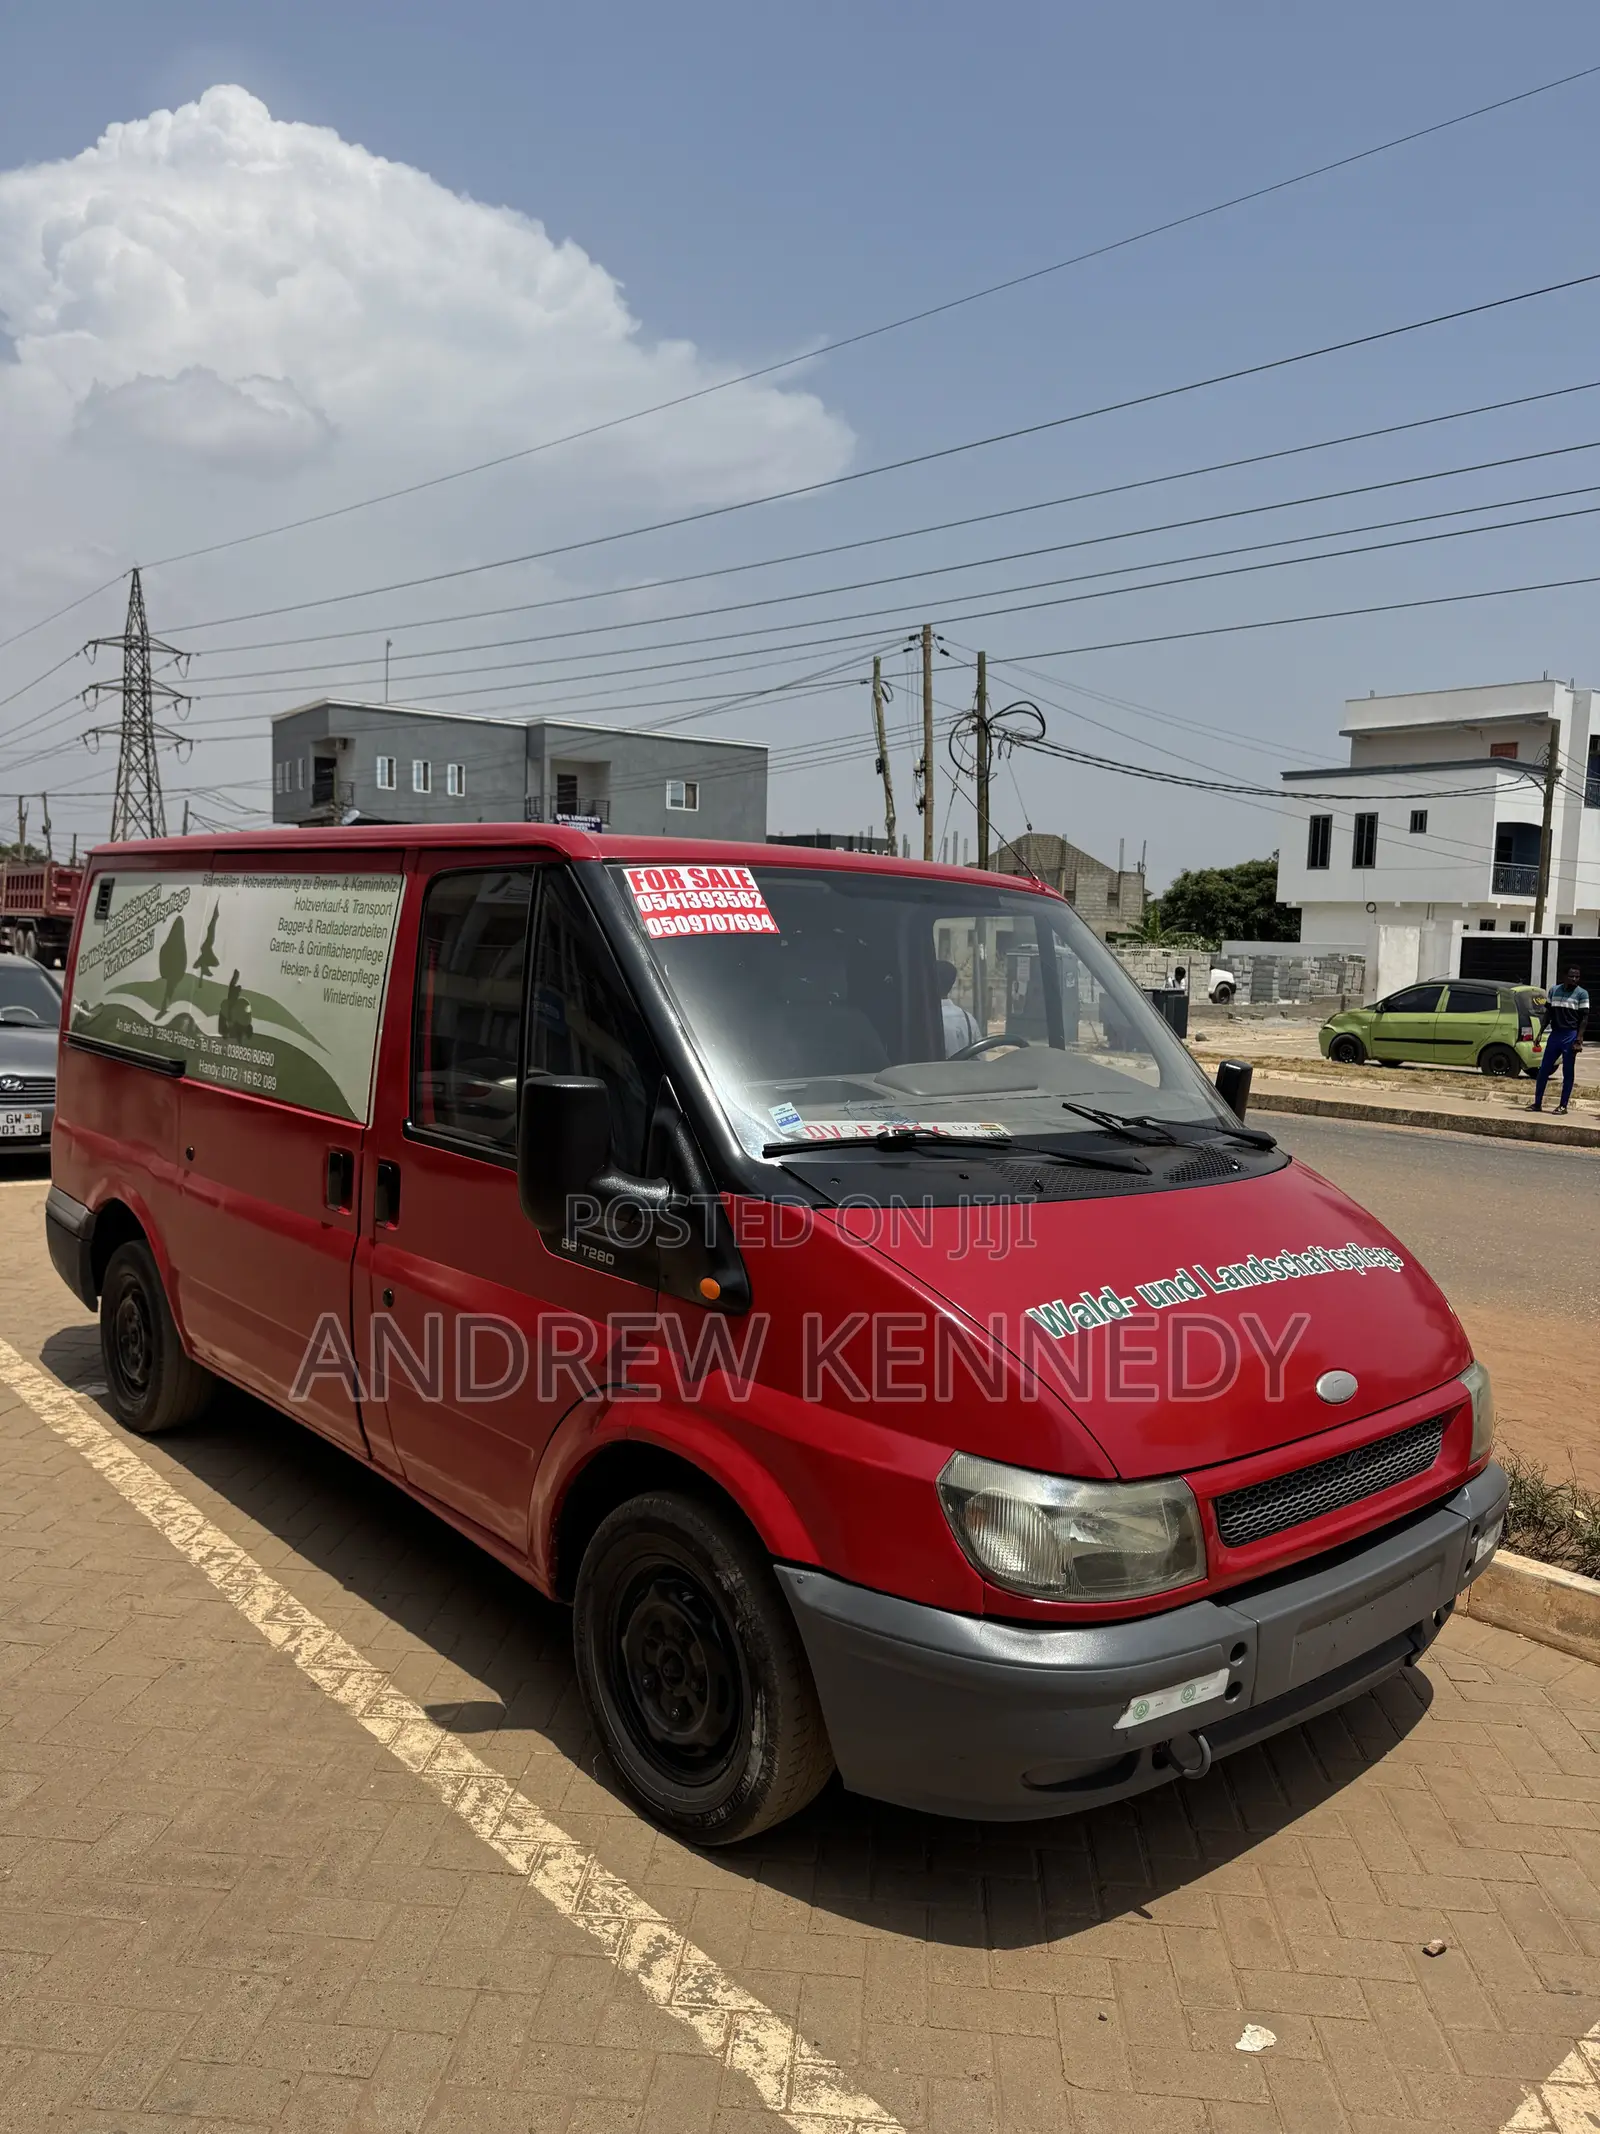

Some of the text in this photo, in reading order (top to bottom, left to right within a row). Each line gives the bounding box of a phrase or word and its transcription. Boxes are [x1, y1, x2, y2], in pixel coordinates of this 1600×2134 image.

[342, 876, 349, 892] &
[628, 867, 755, 892] FOR SALE
[353, 899, 393, 919] Transport
[636, 891, 767, 913] 0541393582
[315, 919, 388, 939] Radladerarbeiten
[645, 914, 775, 936] 0509707694
[269, 937, 384, 966] Garten- & Grünflächenpflege
[280, 960, 380, 988] Hecken- & Grabenpflege
[323, 988, 376, 1009] Winterdienst
[221, 1065, 238, 1081] 0172
[244, 1070, 252, 1084] 16
[253, 1072, 263, 1087] 62
[263, 1075, 277, 1091] 089
[0, 1124, 40, 1135] 01-18
[6, 1114, 22, 1124] GW
[804, 1125, 841, 1140] DV
[581, 1244, 615, 1265] T280
[1026, 1242, 1404, 1340] Wald- und Landschaftspflege
